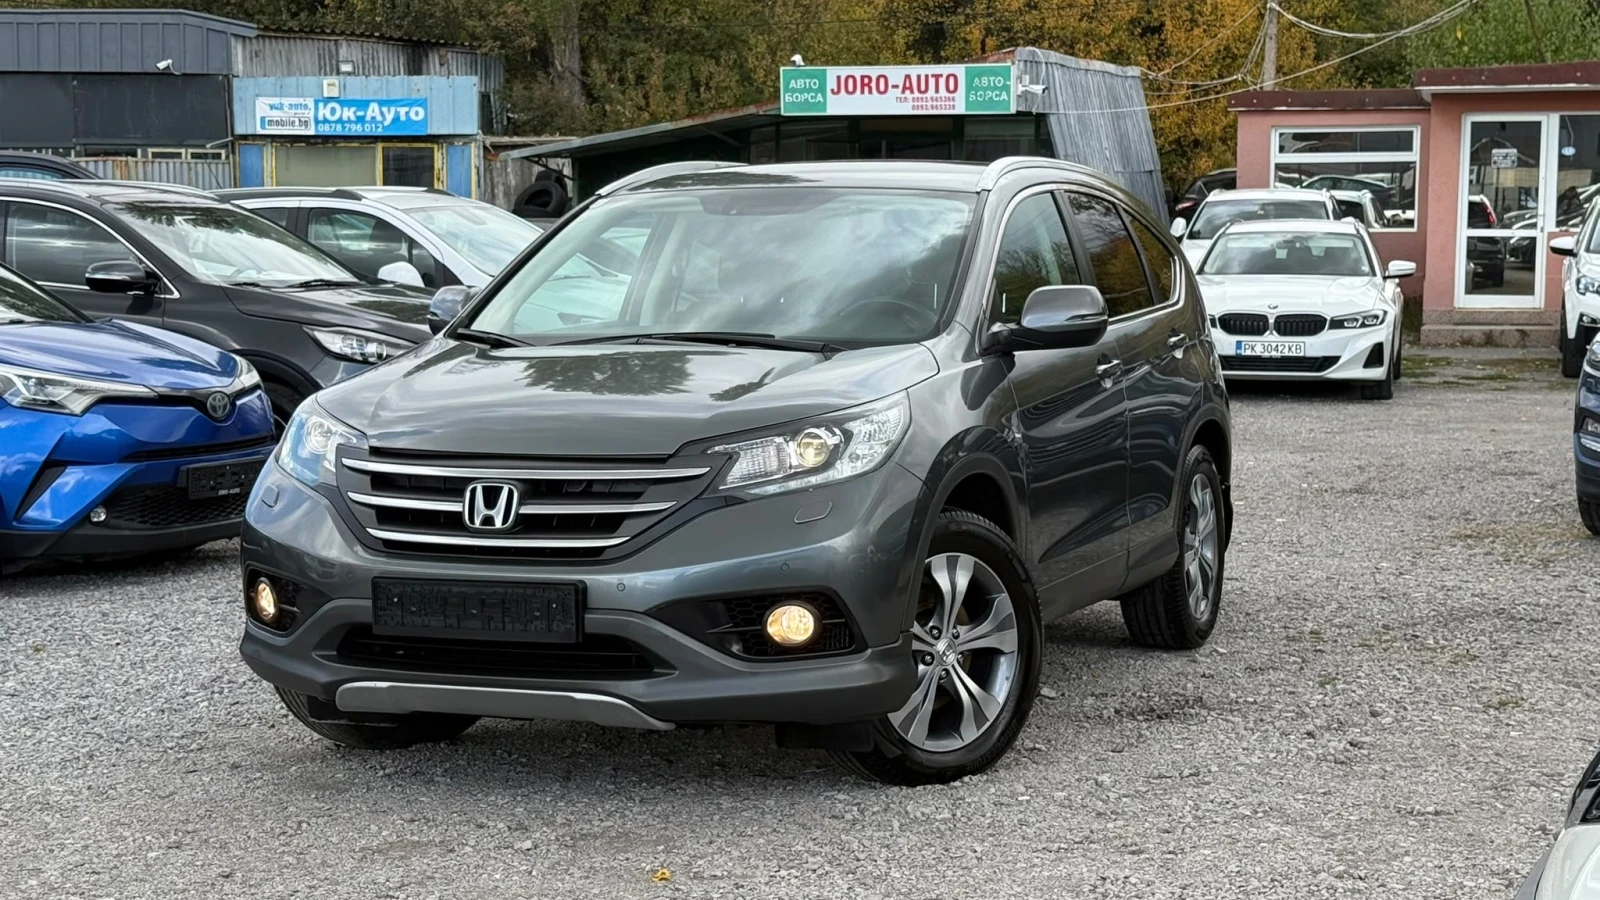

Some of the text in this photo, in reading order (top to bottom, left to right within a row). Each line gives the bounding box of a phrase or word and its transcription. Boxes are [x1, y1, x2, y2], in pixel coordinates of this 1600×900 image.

[789, 79, 819, 89] АВТО
[830, 74, 959, 96] JORO-AUTO
[785, 93, 824, 103] БОРСА
[968, 90, 1008, 102] БОРСА
[317, 102, 425, 126] Юк-Ауто
[267, 118, 309, 129] mobile.bg
[318, 124, 383, 132] 0878 796 012
[1243, 343, 1302, 354] PK 3042 KB
